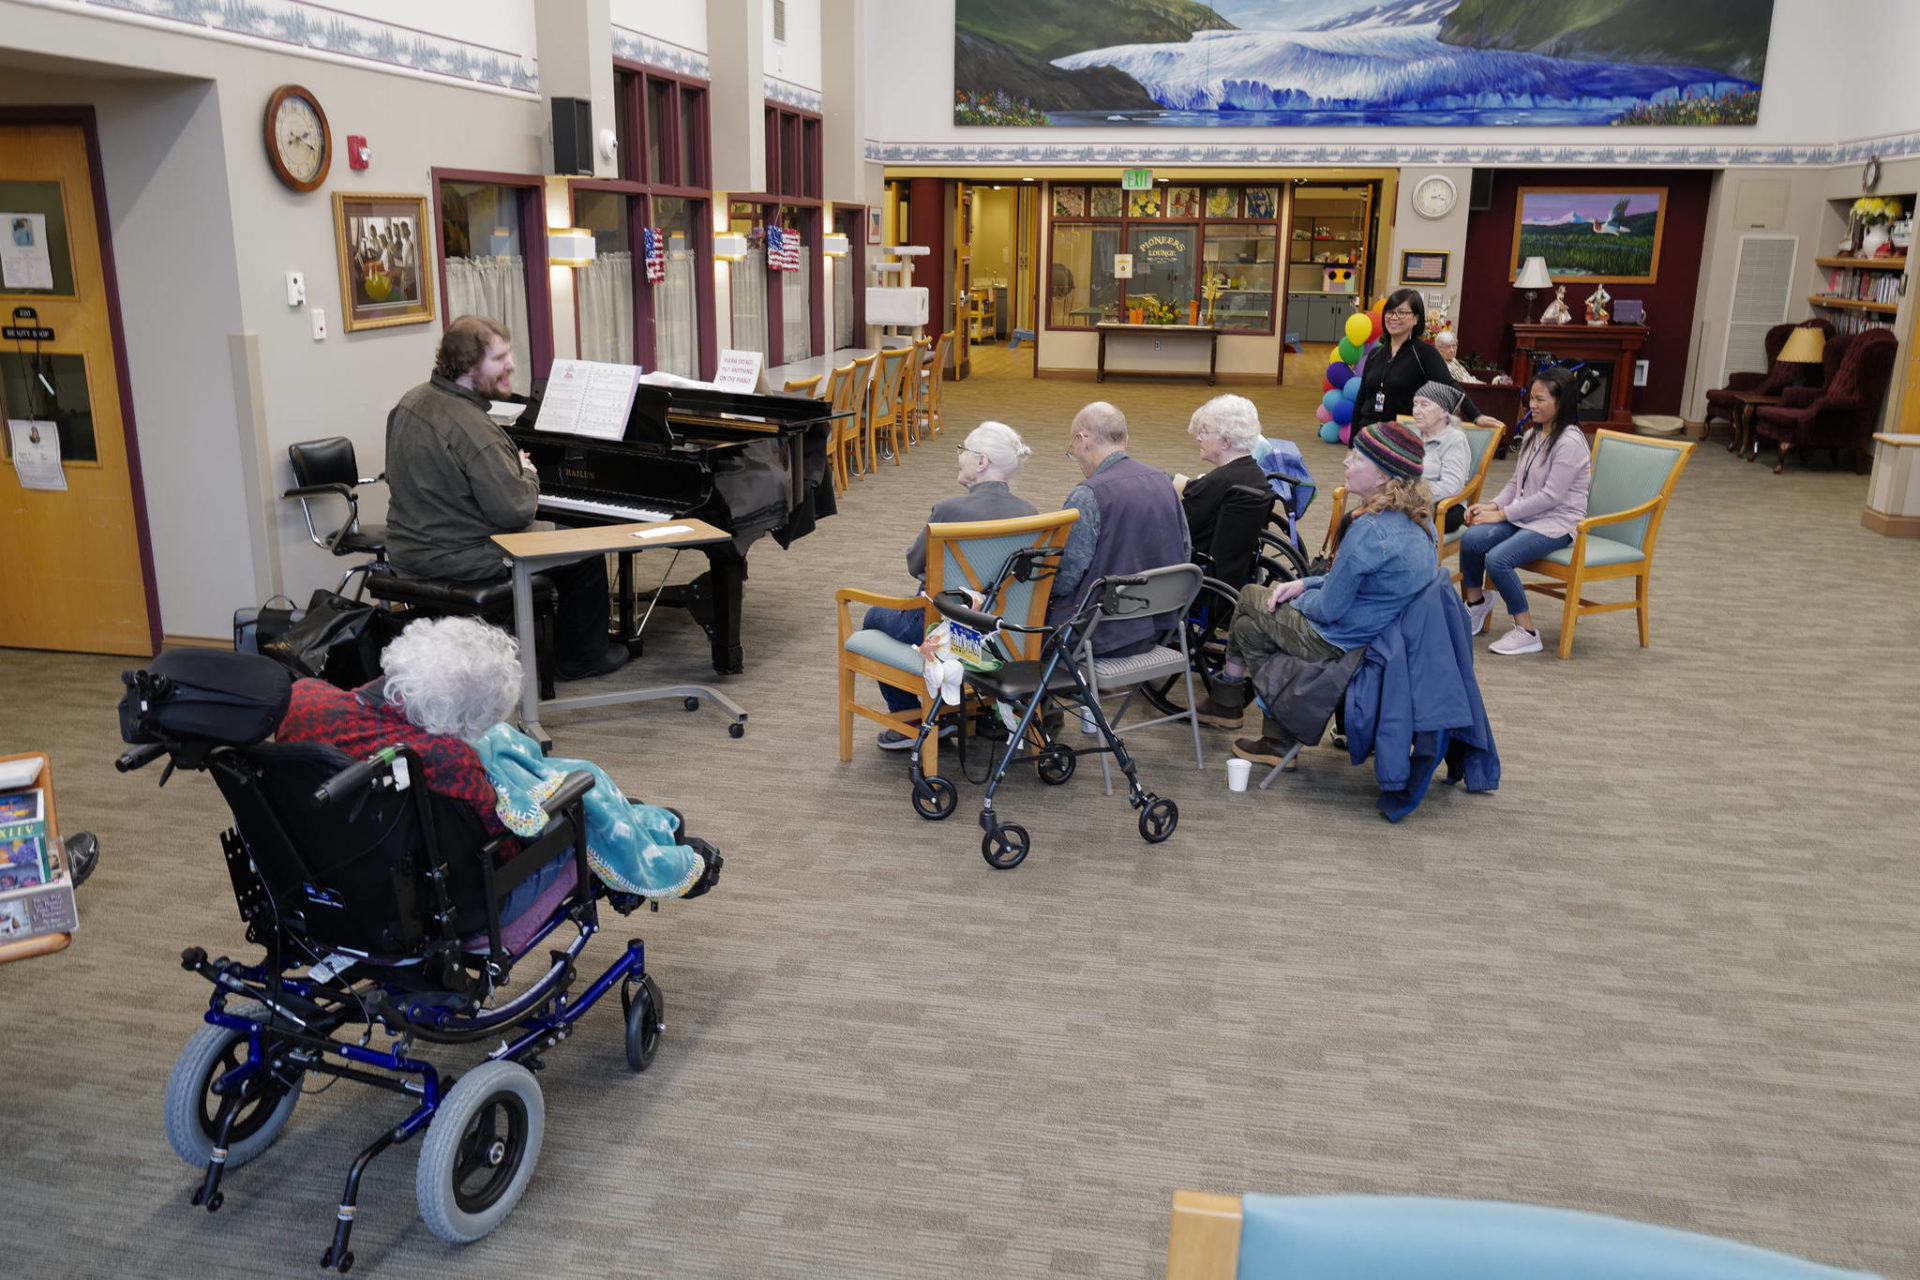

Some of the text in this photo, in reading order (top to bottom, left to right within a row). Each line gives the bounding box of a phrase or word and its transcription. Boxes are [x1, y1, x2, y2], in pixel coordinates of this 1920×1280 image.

[1127, 170, 1149, 188] EXIT
[1140, 236, 1186, 253] PIONEERS
[1148, 249, 1175, 257] LOUNGE
[565, 468, 596, 480] HAILUN
